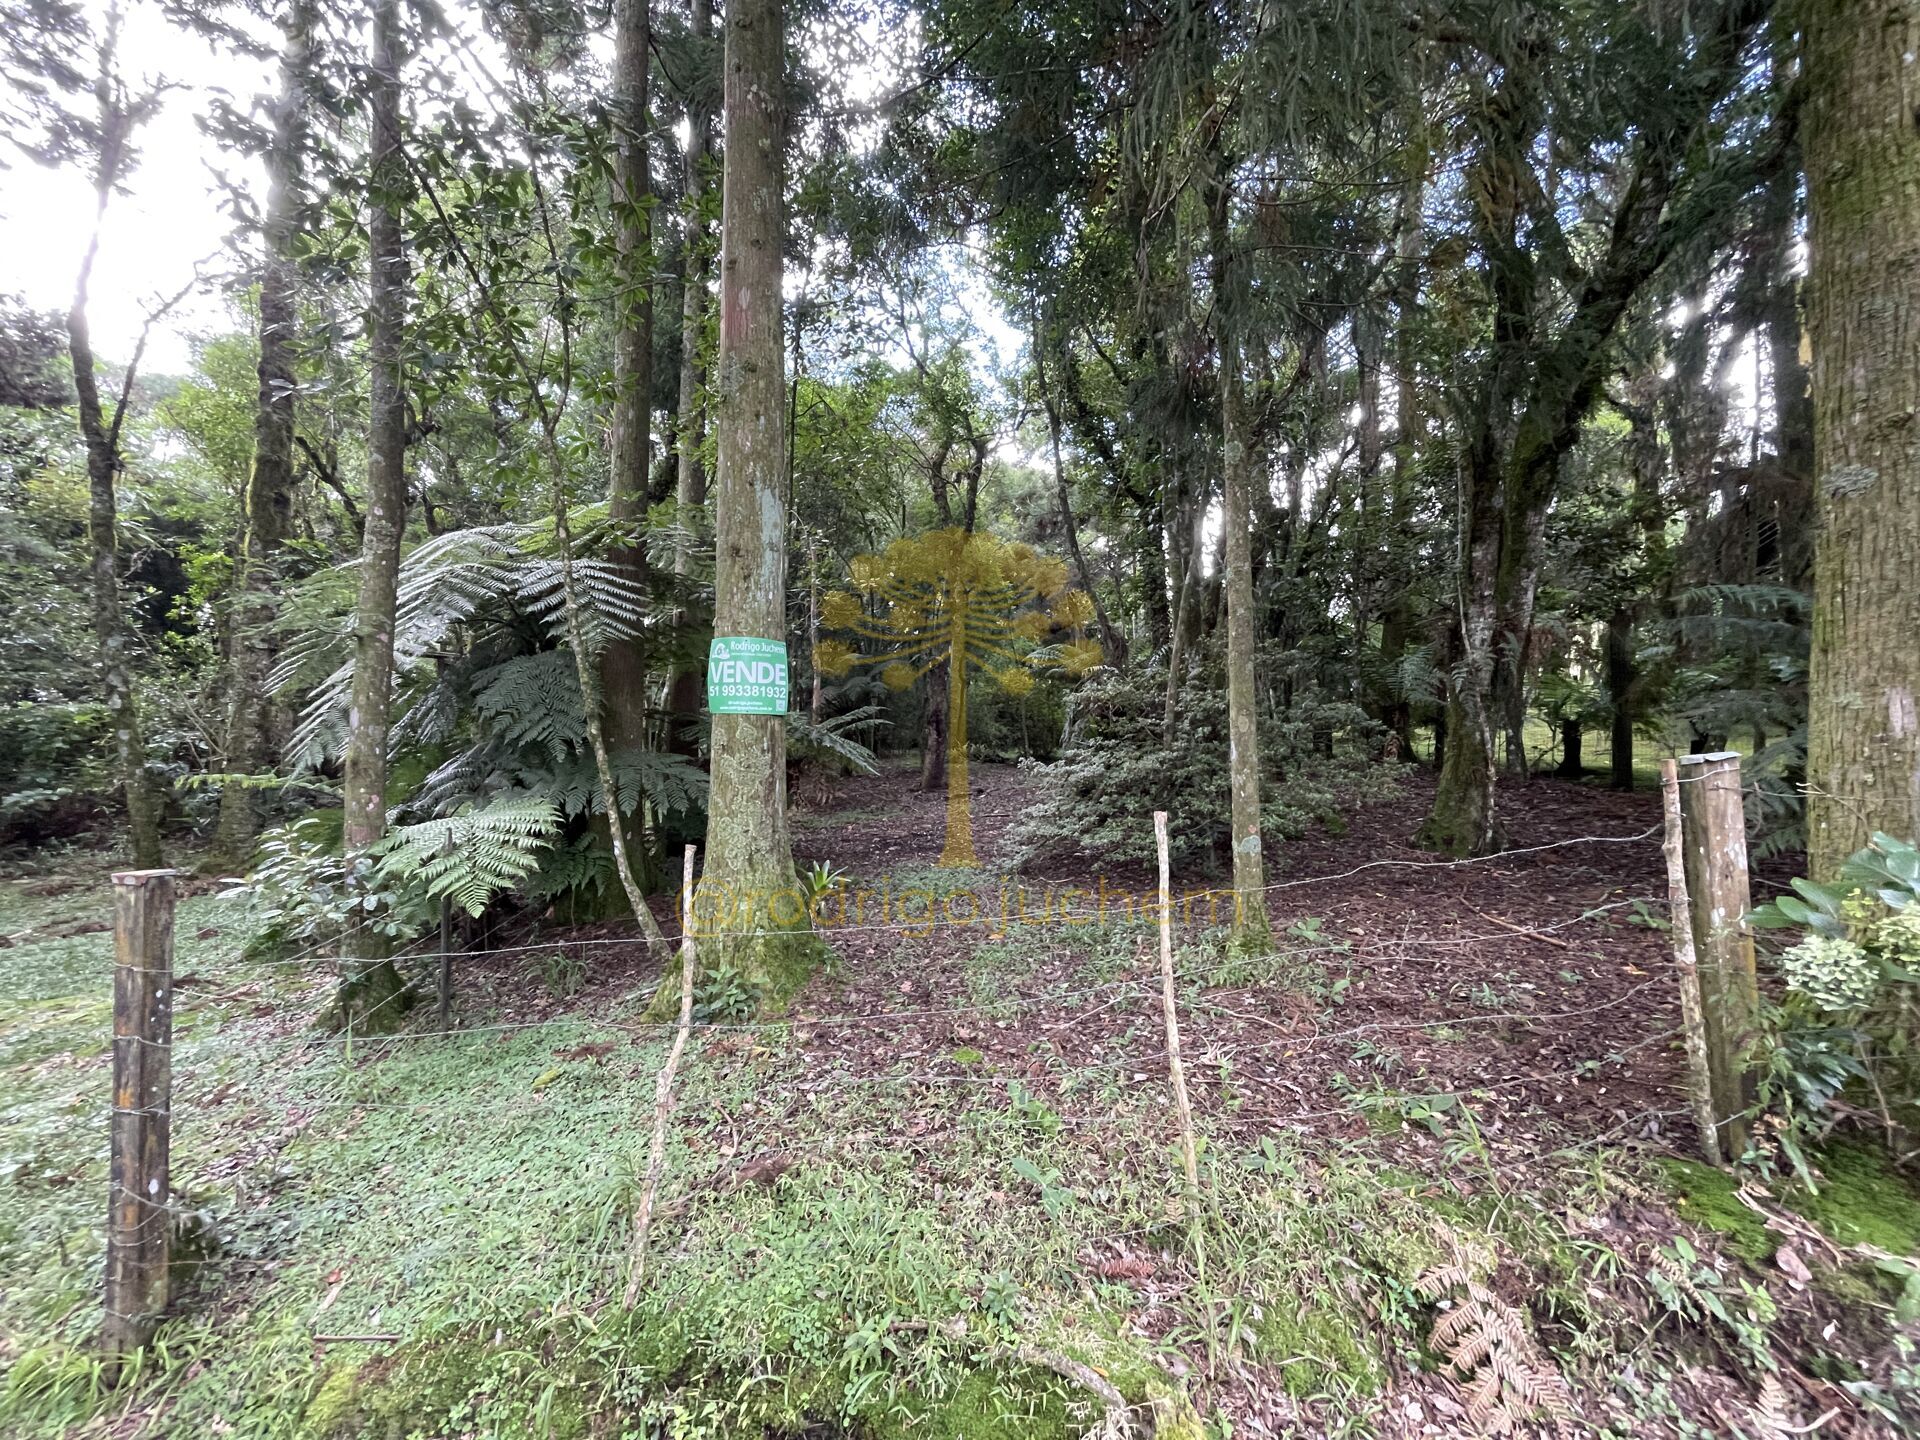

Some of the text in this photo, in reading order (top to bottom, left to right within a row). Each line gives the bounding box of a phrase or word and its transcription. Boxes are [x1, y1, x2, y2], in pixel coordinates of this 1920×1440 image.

[731, 641, 760, 652] Rodrigo
[710, 661, 786, 685] VENDE
[709, 685, 786, 698] 51 993381932
